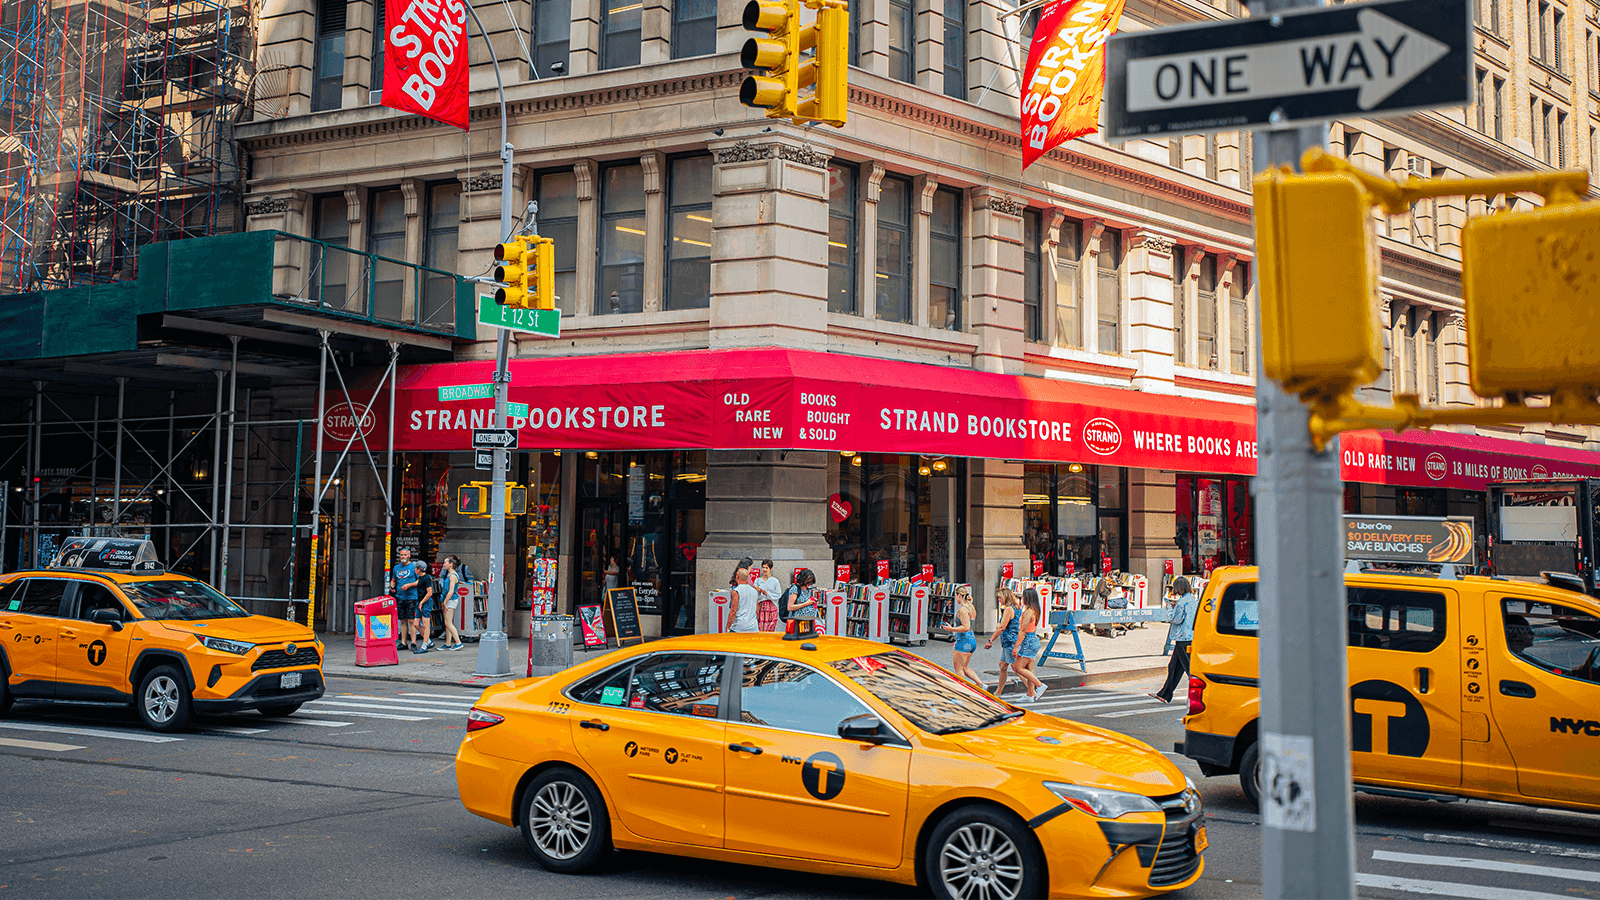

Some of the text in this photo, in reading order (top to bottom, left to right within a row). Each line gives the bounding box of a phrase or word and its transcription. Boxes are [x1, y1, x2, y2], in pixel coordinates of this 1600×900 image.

[401, 0, 467, 111] BOOKS
[1154, 33, 1408, 101] ONE WAY
[1030, 26, 1111, 150] BOOKS
[501, 305, 539, 327] E 12 St
[442, 385, 491, 399] BROADWAY
[724, 393, 750, 405] OLD
[800, 392, 837, 407] BOOKS
[515, 404, 520, 415] 12
[736, 410, 771, 422] RARE
[807, 410, 850, 425] BOUGHT
[880, 408, 1072, 442] STRAND BOOKSTORE
[479, 434, 512, 442] ONE WAY
[753, 427, 783, 439] NEW
[808, 427, 837, 441] SOLD
[1086, 429, 1119, 443] STRAND
[1133, 430, 1258, 459] WHERE BOOKS ARE
[1344, 450, 1416, 472] OLD RARE NEW
[1427, 461, 1446, 471] STRAND
[1453, 461, 1528, 480] 18 MILES OF BOOKS
[1356, 522, 1392, 530] Uber One
[1348, 532, 1432, 544] $0 DELIVERY FEE
[1348, 541, 1424, 553] SAVE BUNCHES
[638, 587, 658, 596] Everyday
[92, 645, 104, 663] T
[1353, 697, 1407, 754] T
[1550, 717, 1600, 737] NYC
[782, 755, 801, 765] NYC
[811, 760, 838, 794] T
